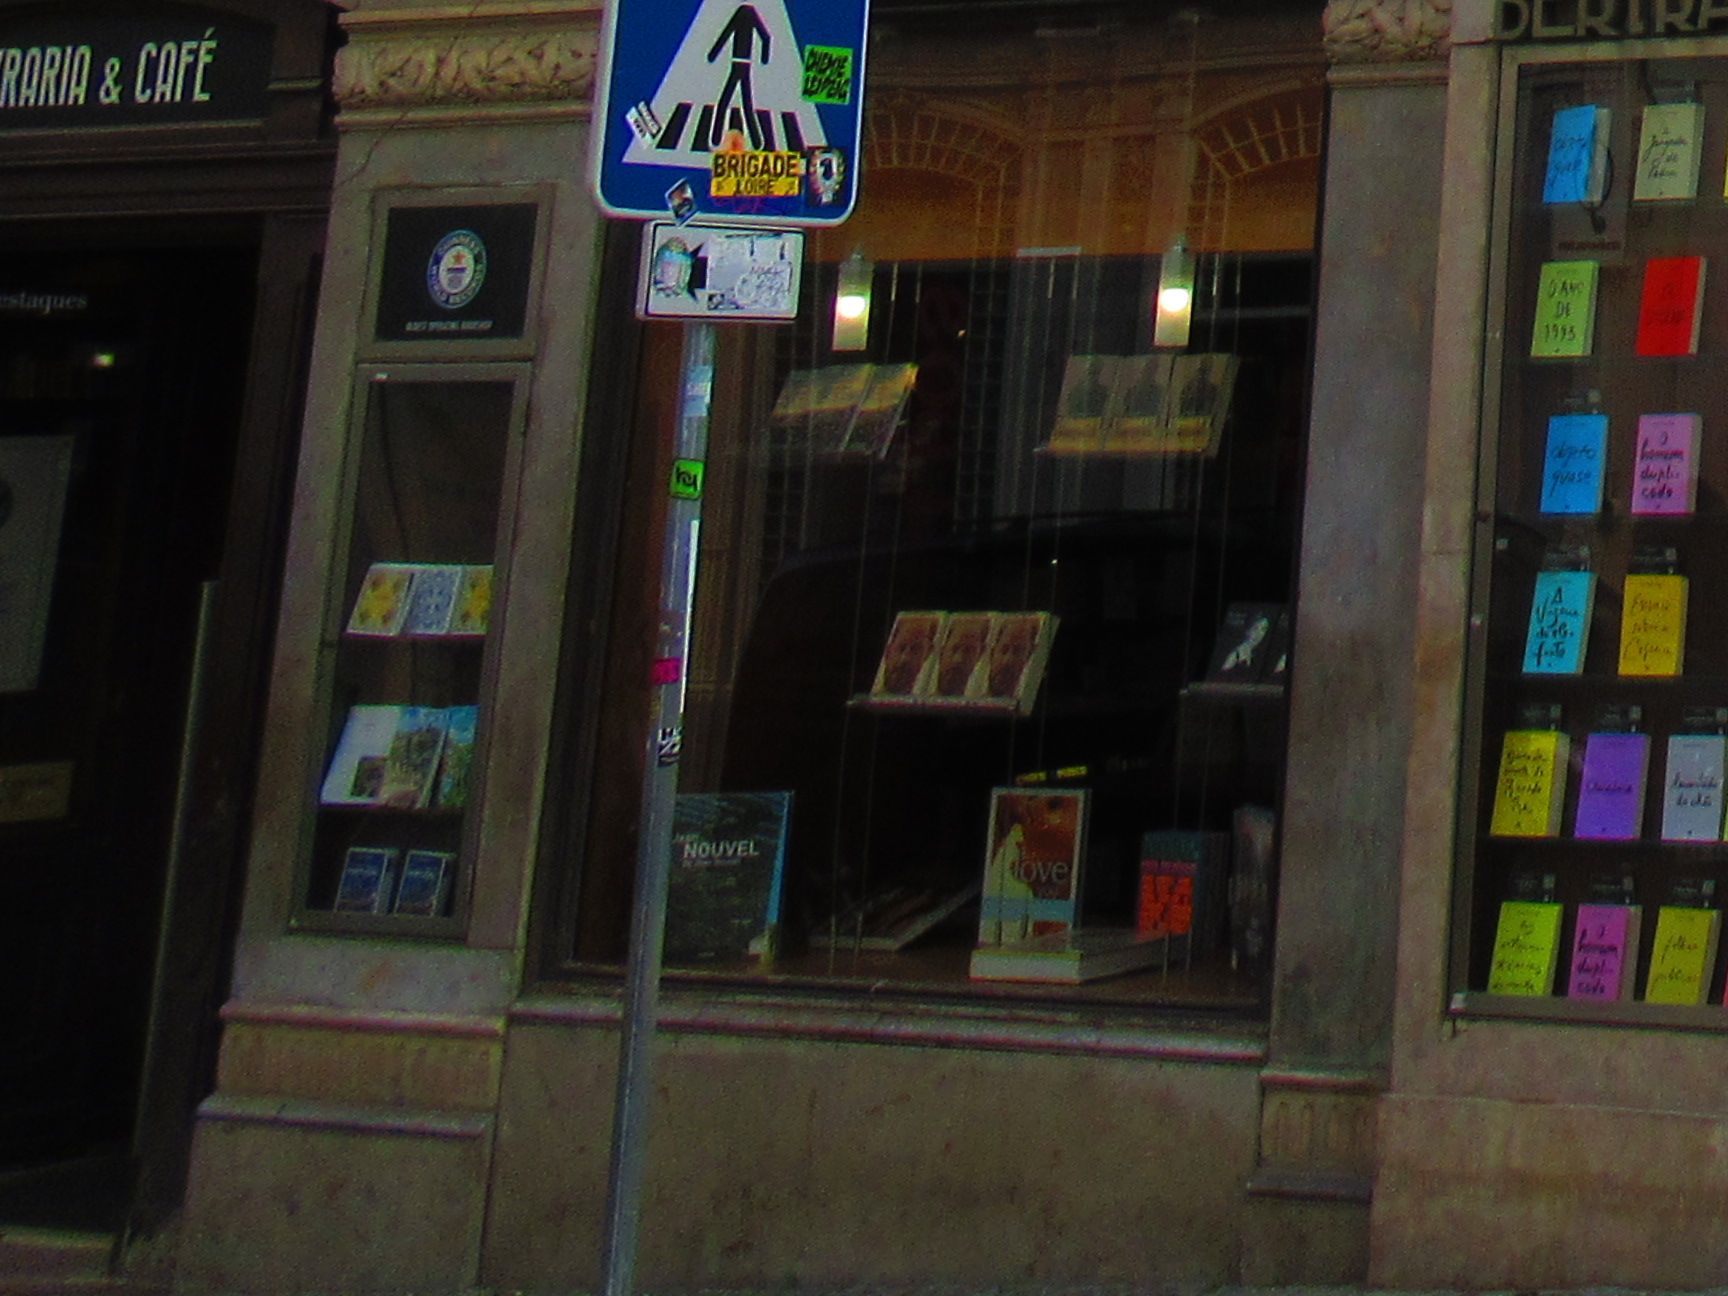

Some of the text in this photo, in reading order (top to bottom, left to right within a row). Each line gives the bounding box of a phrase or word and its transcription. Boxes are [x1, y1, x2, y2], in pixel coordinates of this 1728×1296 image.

[99, 57, 123, 105] &
[134, 27, 218, 104] CAFÉ
[713, 154, 799, 178] BRIGADE
[683, 839, 760, 859] NOUVEL
